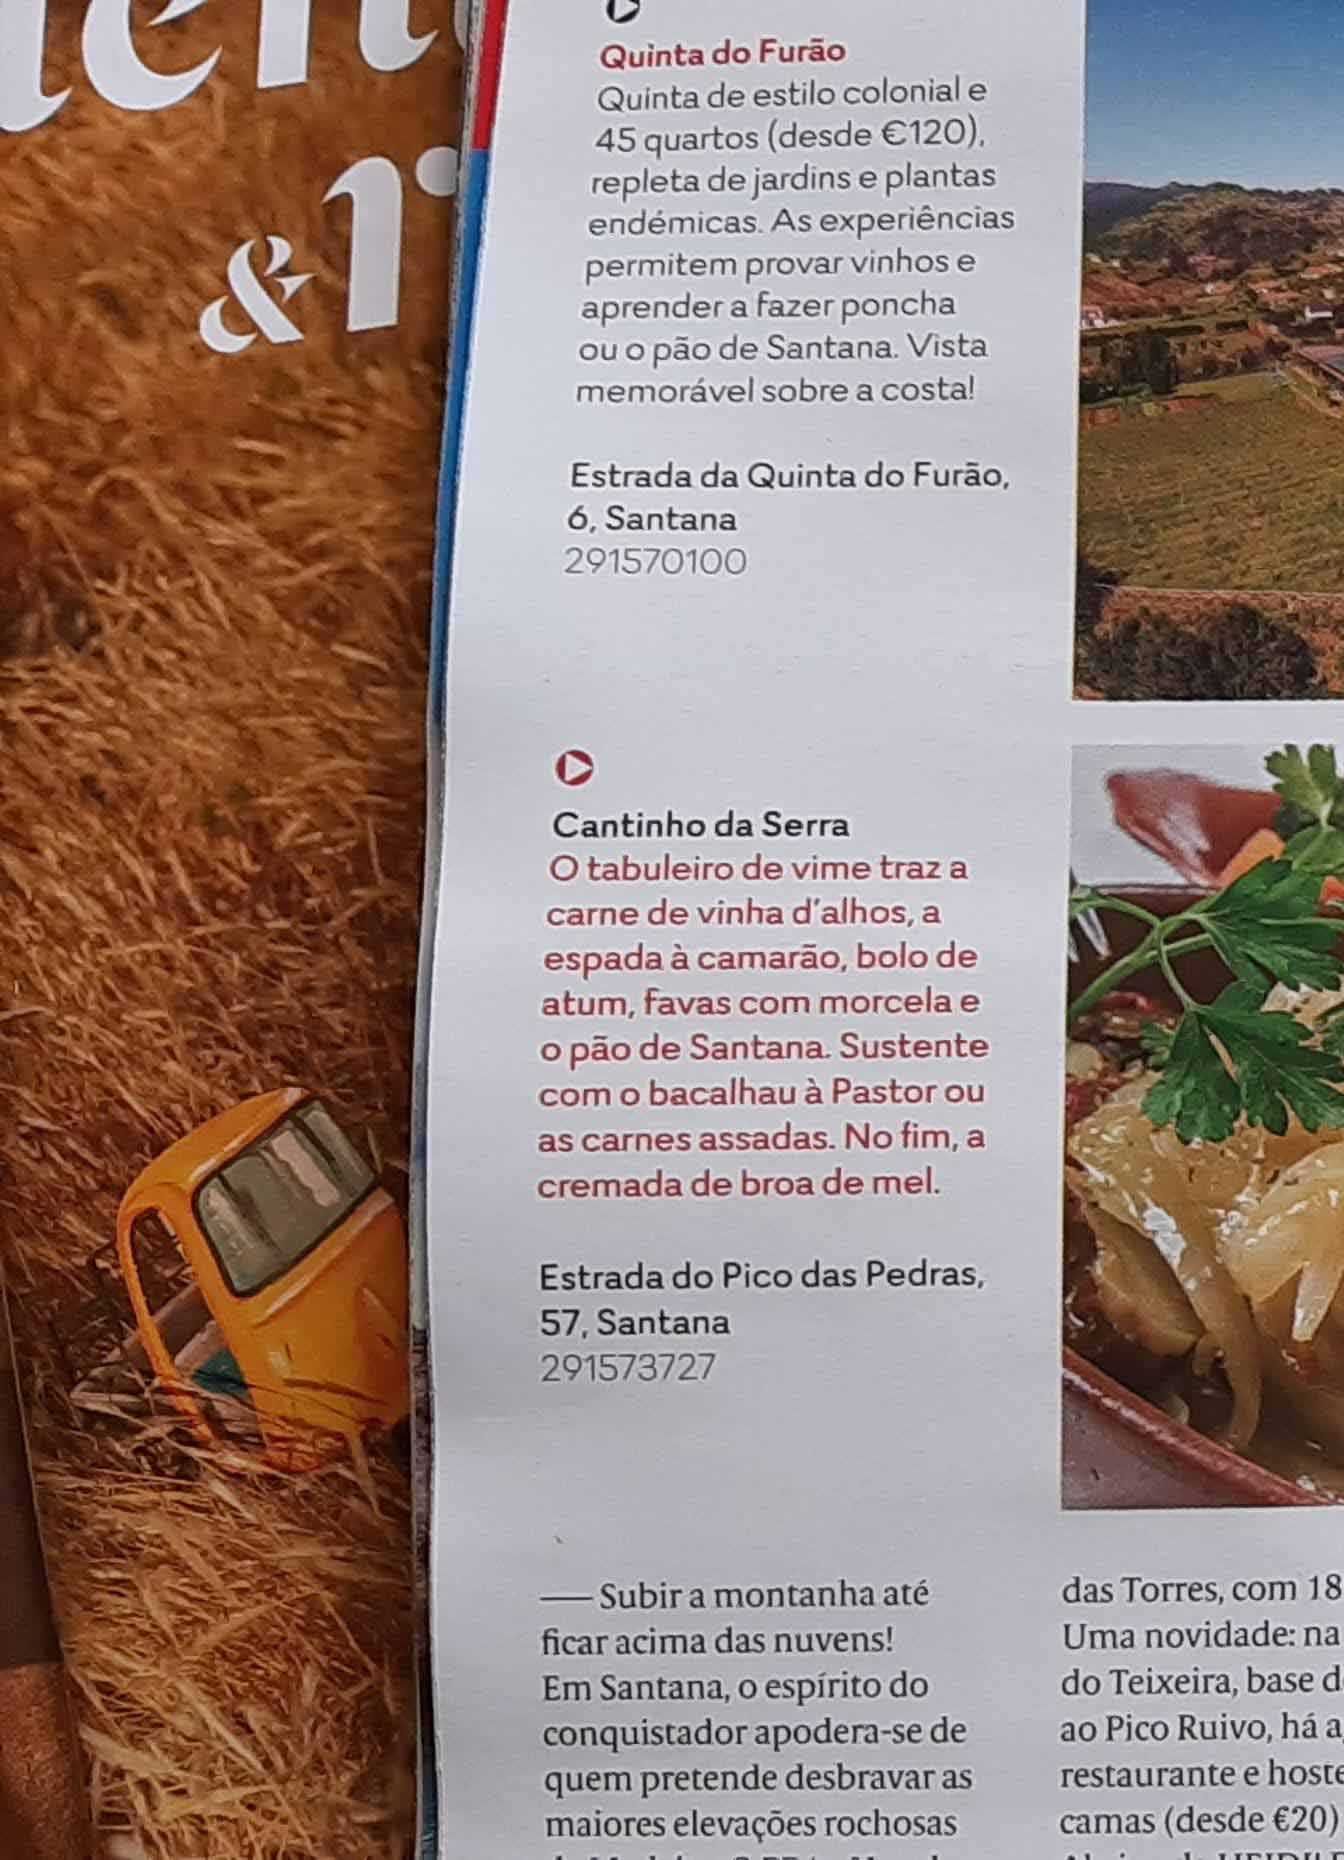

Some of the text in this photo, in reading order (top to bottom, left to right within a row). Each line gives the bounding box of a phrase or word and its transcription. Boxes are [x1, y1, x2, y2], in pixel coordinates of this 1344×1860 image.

[600, 38, 846, 71] Quinta do Furão
[595, 112, 984, 160] 45 quartos (desde €120),
[589, 205, 1014, 240] endémicas. As experiências
[586, 246, 976, 286] permitem provar vinhos e
[577, 374, 974, 403] memorável sobre a costa!
[571, 461, 1009, 490] Estrada da Quinta do Furão,
[568, 505, 738, 534] 6, Santana
[565, 547, 746, 575] 291570100
[553, 809, 850, 838] Cantinho da Serra
[544, 940, 978, 981] espada à camarão, bolo de
[542, 985, 980, 1019] atum, favas com morcela e
[538, 1166, 940, 1198] cremada de broa de mel.
[541, 1258, 984, 1291] Estrada do Pico das Pedras,
[541, 1308, 730, 1340] 57, Santana
[542, 1347, 716, 1382] 291573727
[600, 1579, 928, 1609] Subir a montanha até
[1061, 1575, 1115, 1605] das
[1119, 1576, 1225, 1607] Torres,
[1231, 1580, 1297, 1603] com
[542, 1626, 892, 1656] ficar acima das nuvens!
[1064, 1624, 1134, 1650] Uma
[1145, 1619, 1295, 1648] novidade:
[1304, 1626, 1340, 1646] na
[544, 1716, 966, 1754] conquistador apodera-se de
[546, 1808, 956, 1844] maiores elevações rochosas
[1060, 1814, 1155, 1834] camas
[1165, 1805, 1264, 1838] (desde
[1272, 1804, 1339, 1838] €20)
